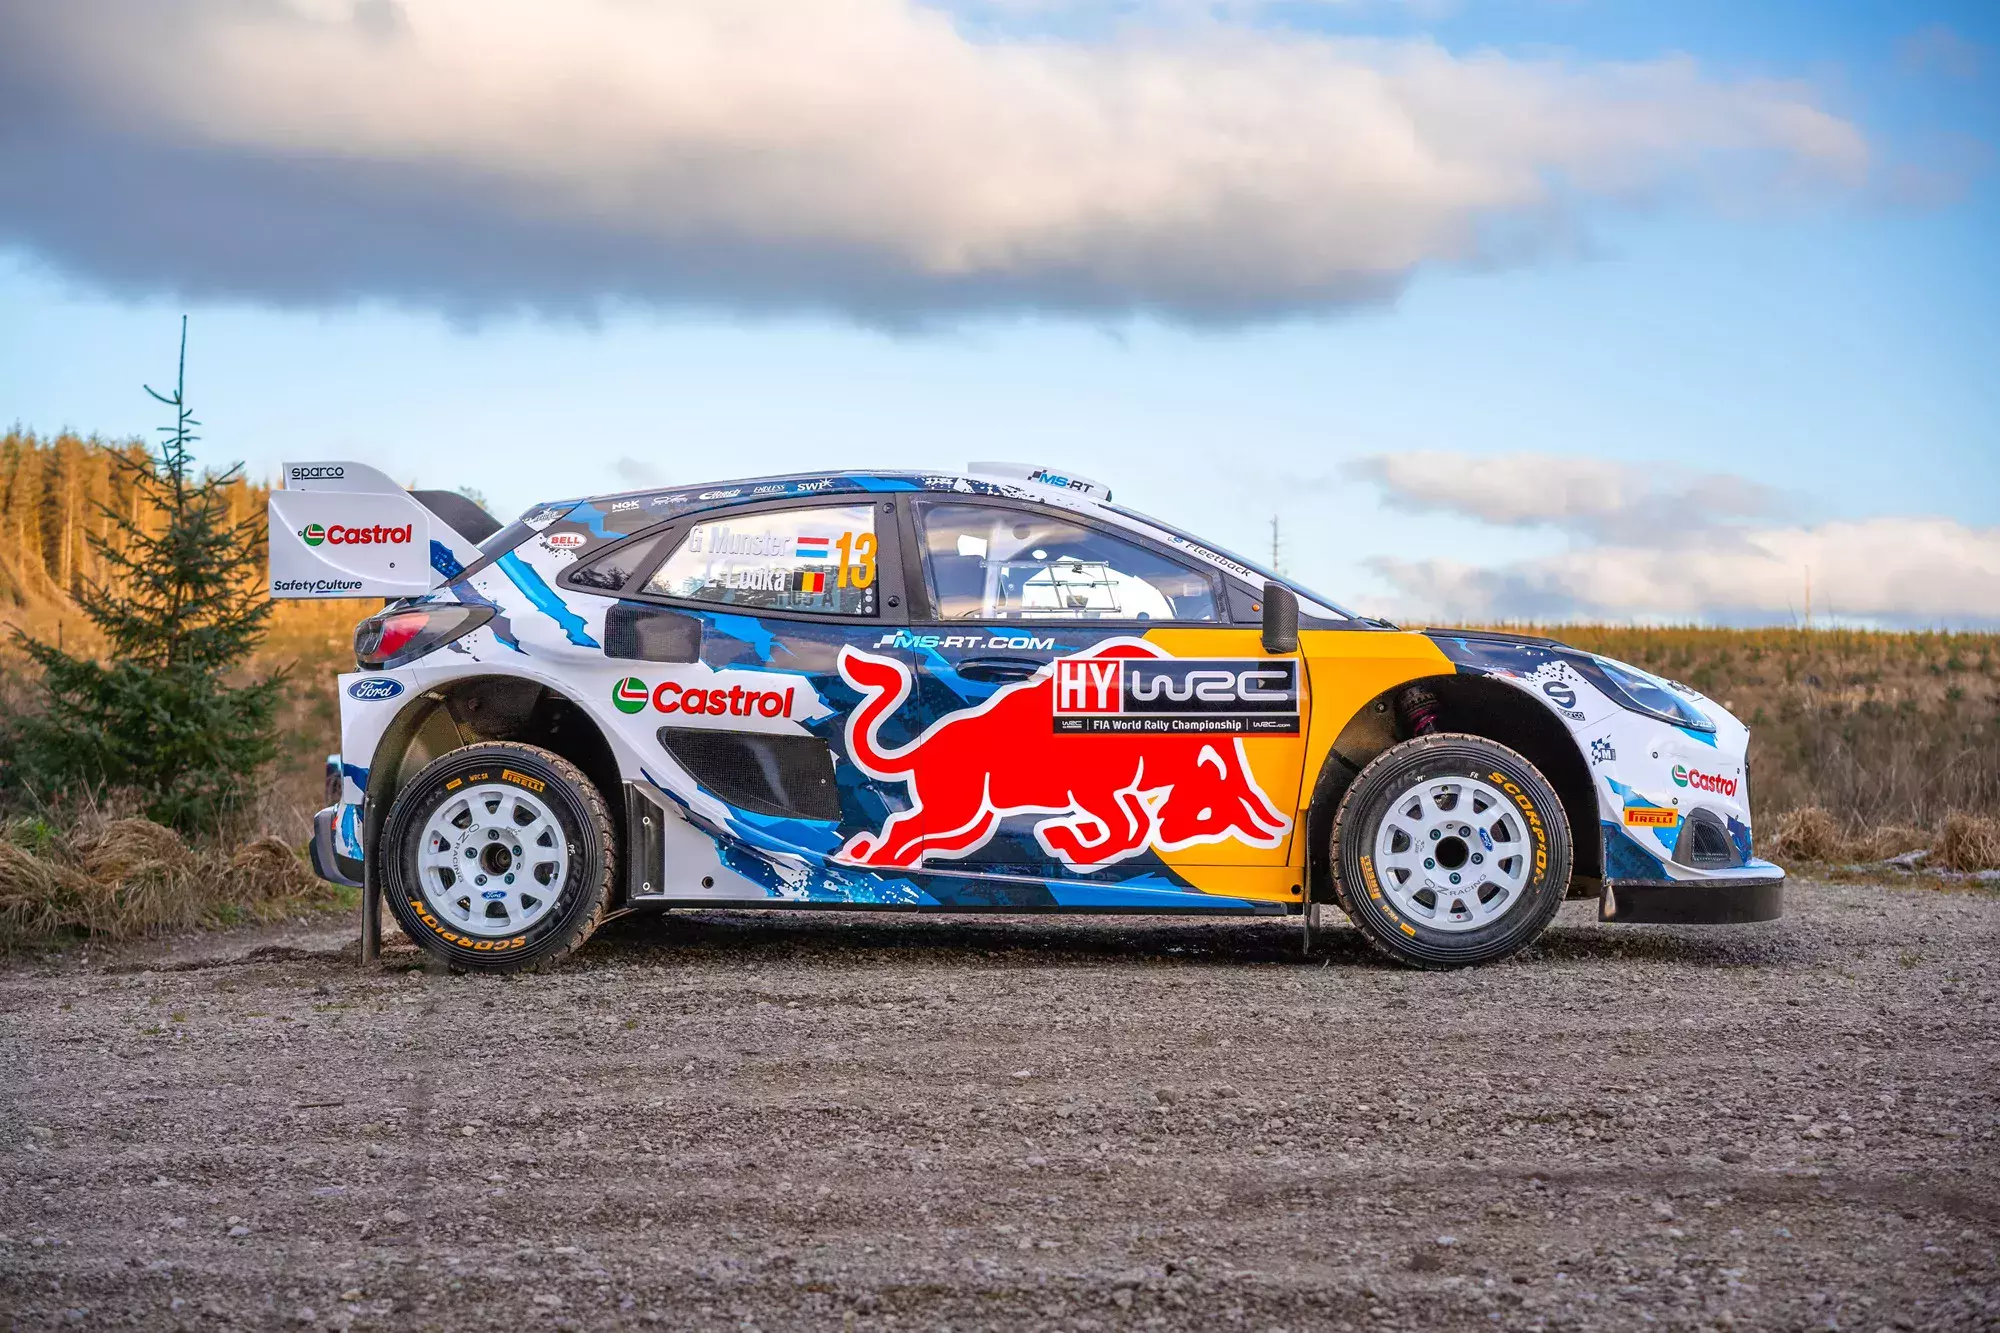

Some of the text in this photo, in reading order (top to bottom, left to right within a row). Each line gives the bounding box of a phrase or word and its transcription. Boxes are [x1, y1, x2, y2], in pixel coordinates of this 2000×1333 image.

[291, 467, 344, 480] sparco
[753, 484, 785, 493] ENDLESS
[612, 500, 640, 510] NGK
[327, 524, 412, 545] Castrol
[551, 536, 580, 545] BELL
[689, 525, 792, 558] G Munster
[836, 531, 878, 589] 13
[1185, 543, 1252, 577] Fleetback
[274, 580, 362, 593] SafetyCulture
[725, 560, 786, 592] Louka
[652, 681, 795, 718] Castrol
[1060, 663, 1117, 709] HY
[1132, 670, 1289, 702] WRC
[1093, 720, 1242, 731] FIA World Rally Championship
[502, 769, 546, 793] PIRELLI
[1688, 768, 1737, 797] Castrol
[1628, 810, 1674, 824] PIRELLI
[452, 842, 464, 883] RACING
[1360, 855, 1382, 900] PIRELLI
[1449, 873, 1487, 896] RACING
[410, 901, 527, 950] SCORPION
